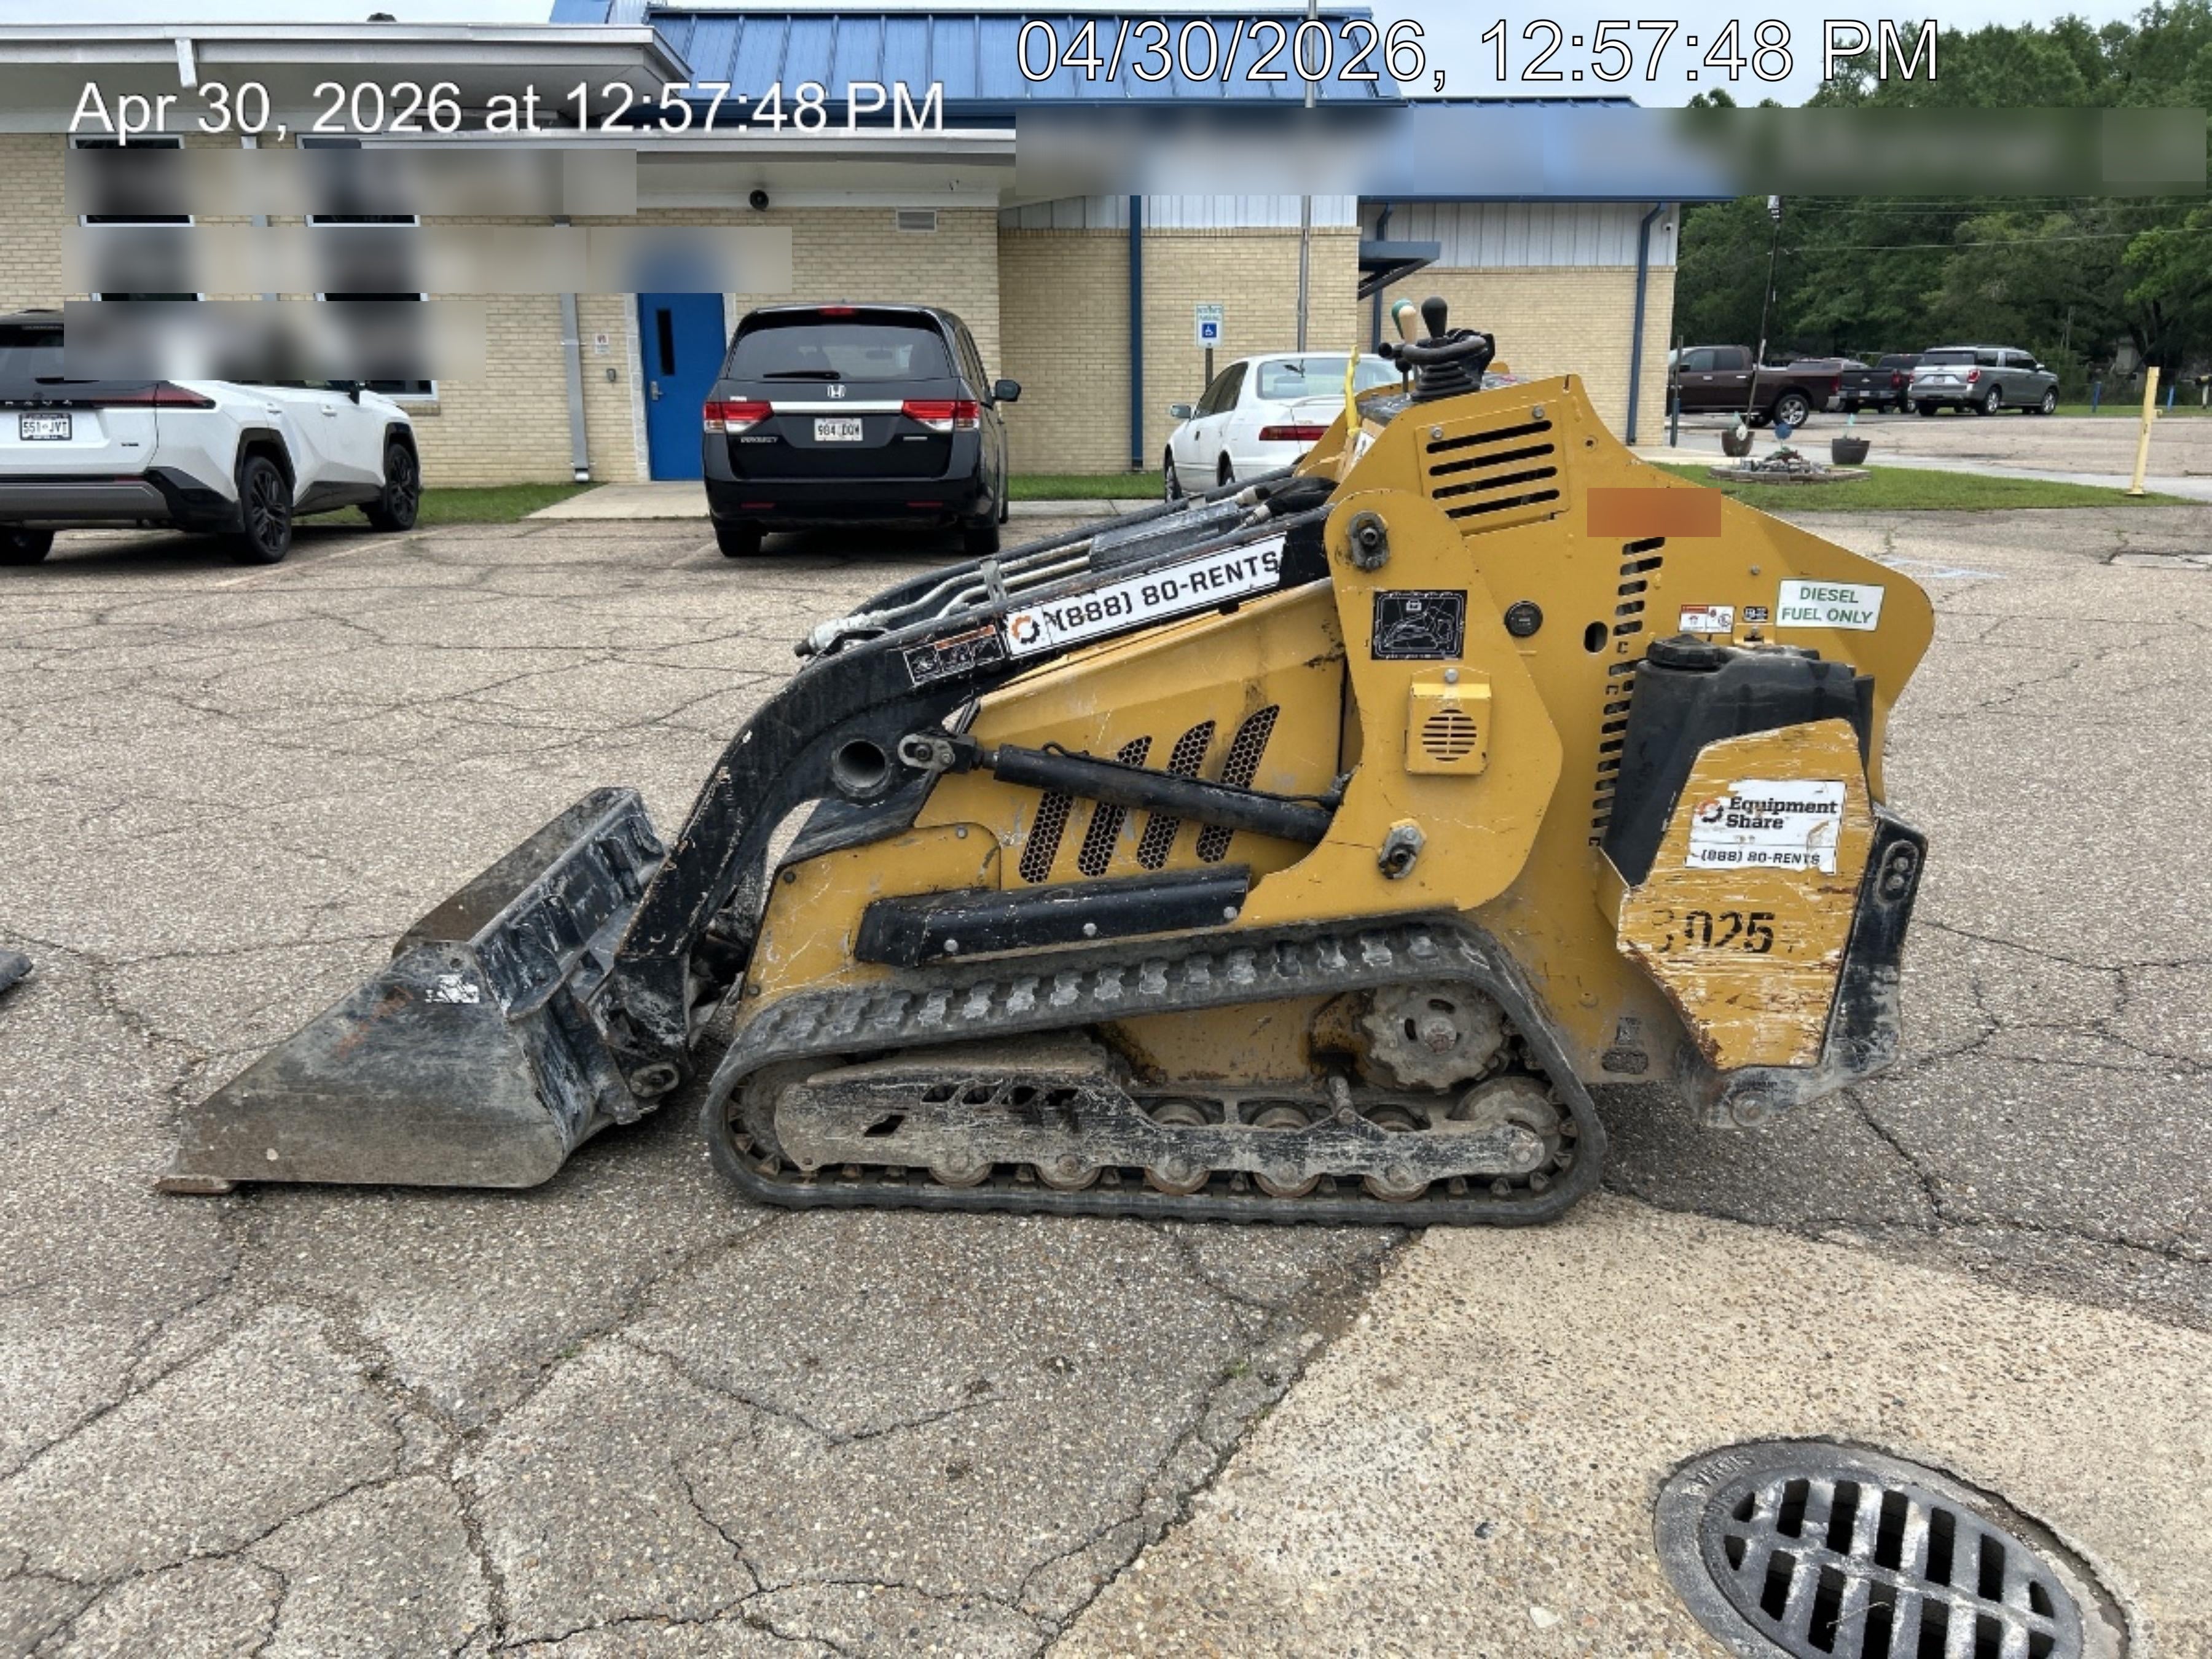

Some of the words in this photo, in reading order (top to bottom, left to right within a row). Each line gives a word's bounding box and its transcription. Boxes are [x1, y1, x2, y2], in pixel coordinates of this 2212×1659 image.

[1056, 591, 1132, 631] (888)
[1140, 551, 1280, 606] 80-RENTS
[1800, 586, 1859, 604] DIESEL
[1781, 607, 1822, 621] FUEL
[1826, 608, 1873, 624] ONLY
[1728, 796, 1838, 815] Equipment
[1725, 814, 1784, 830] Share
[1746, 850, 1821, 865] 80-RENTS
